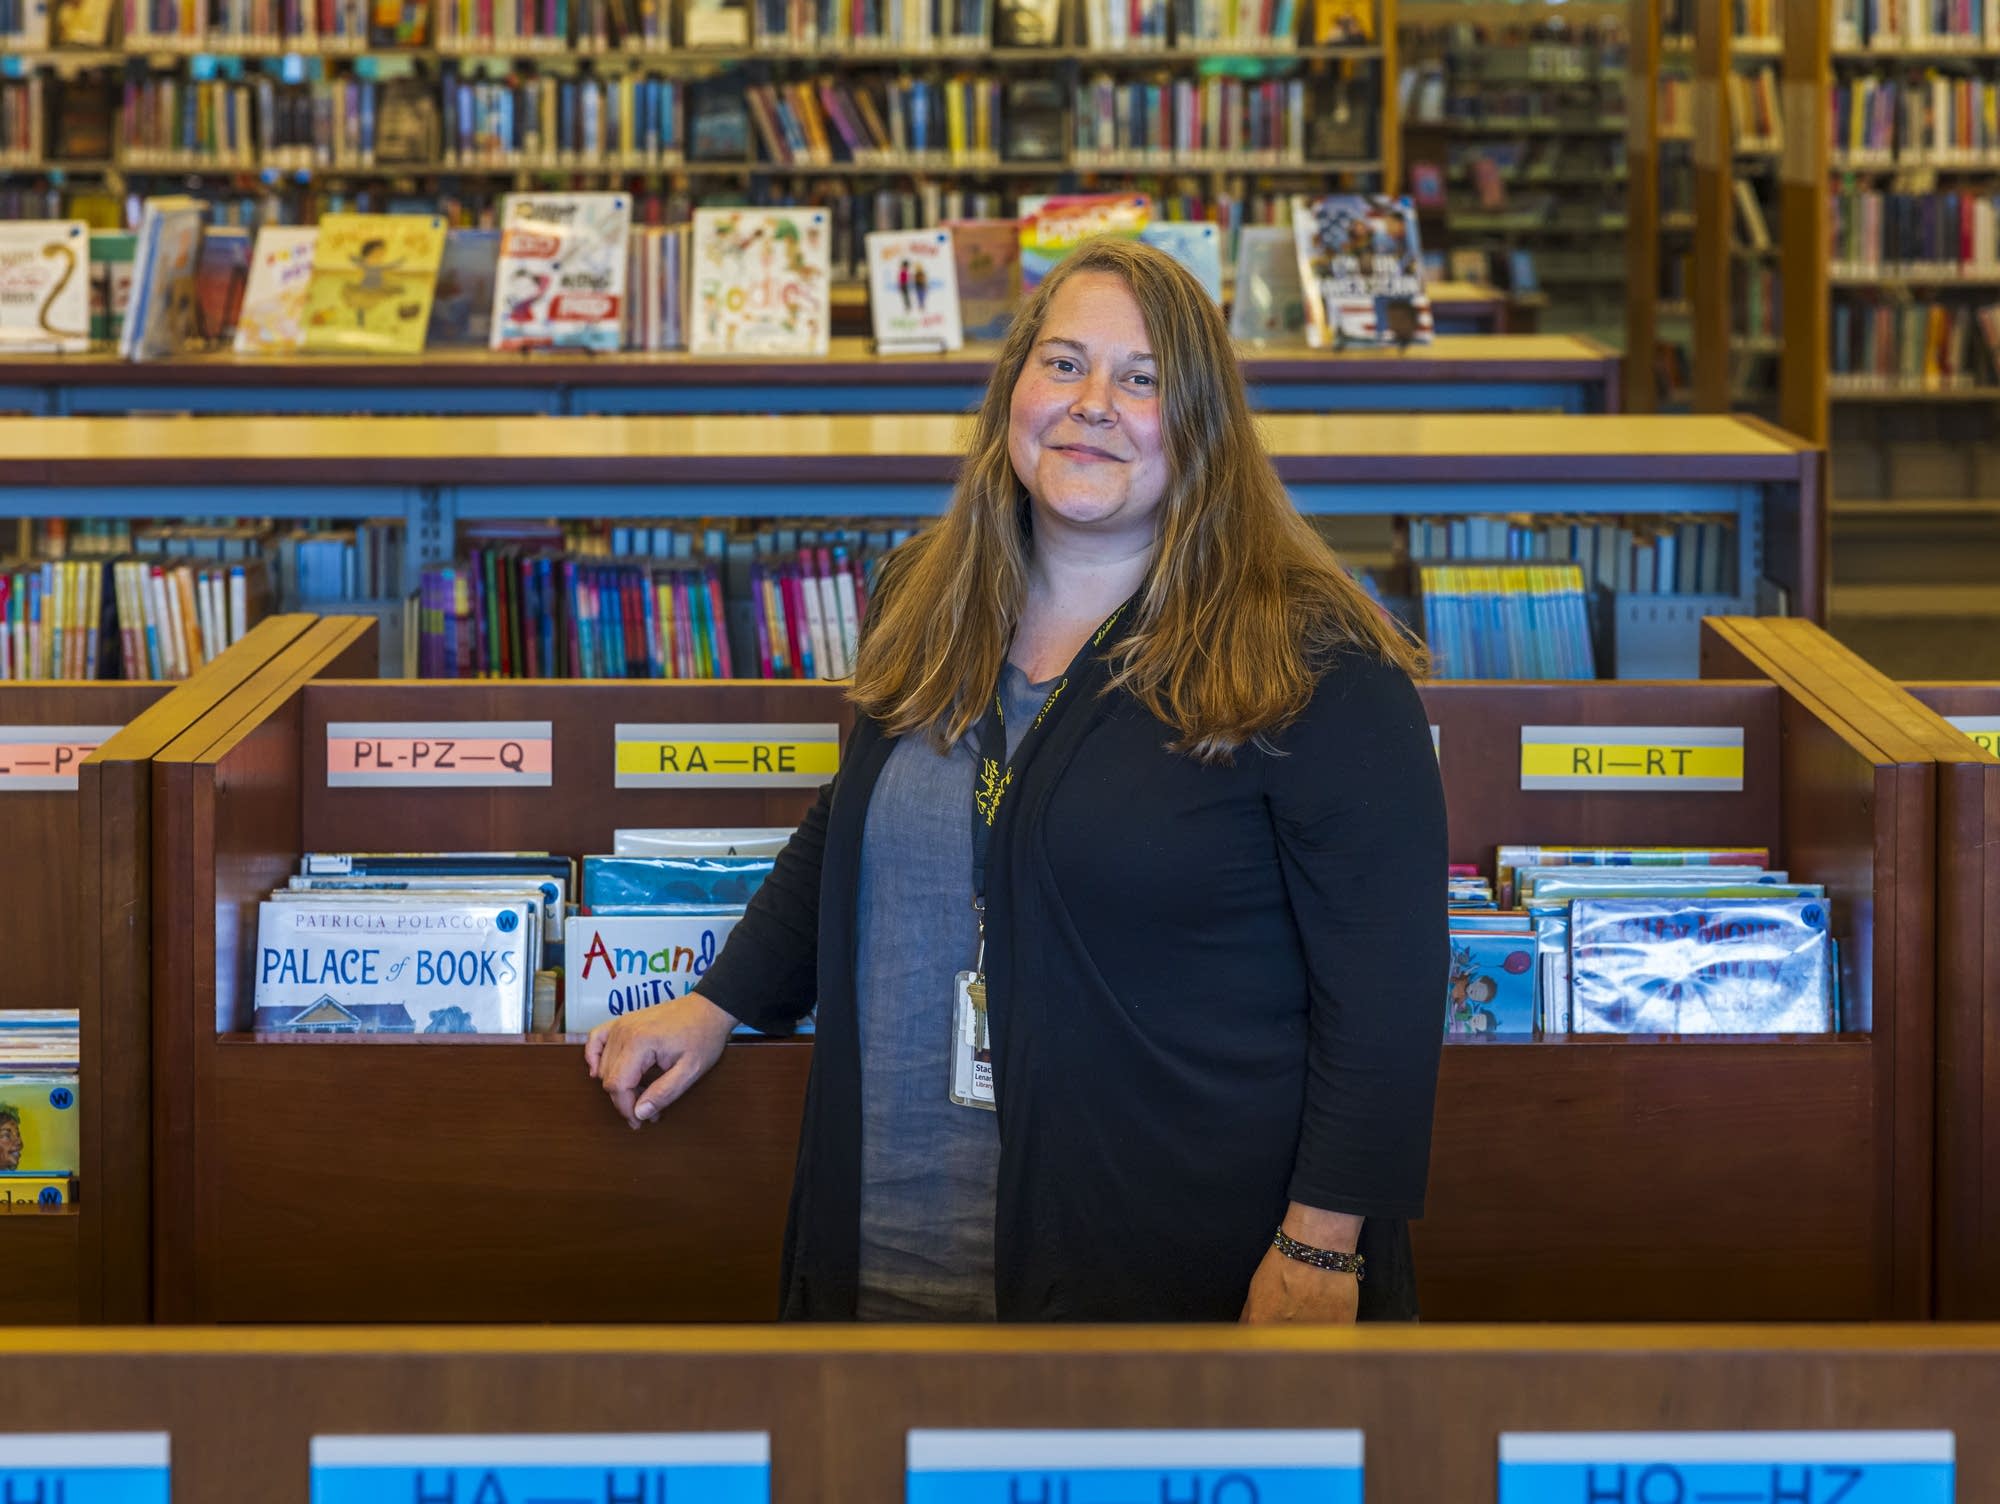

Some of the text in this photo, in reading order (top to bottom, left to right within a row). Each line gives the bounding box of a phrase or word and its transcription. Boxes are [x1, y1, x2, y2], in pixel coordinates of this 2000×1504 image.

[295, 913, 489, 930] PATRICIA POLACCO
[581, 930, 716, 979] Amand
[262, 948, 518, 987] PALACE of BOOKS
[976, 1064, 992, 1073] Stac
[52, 1092, 68, 1106] W
